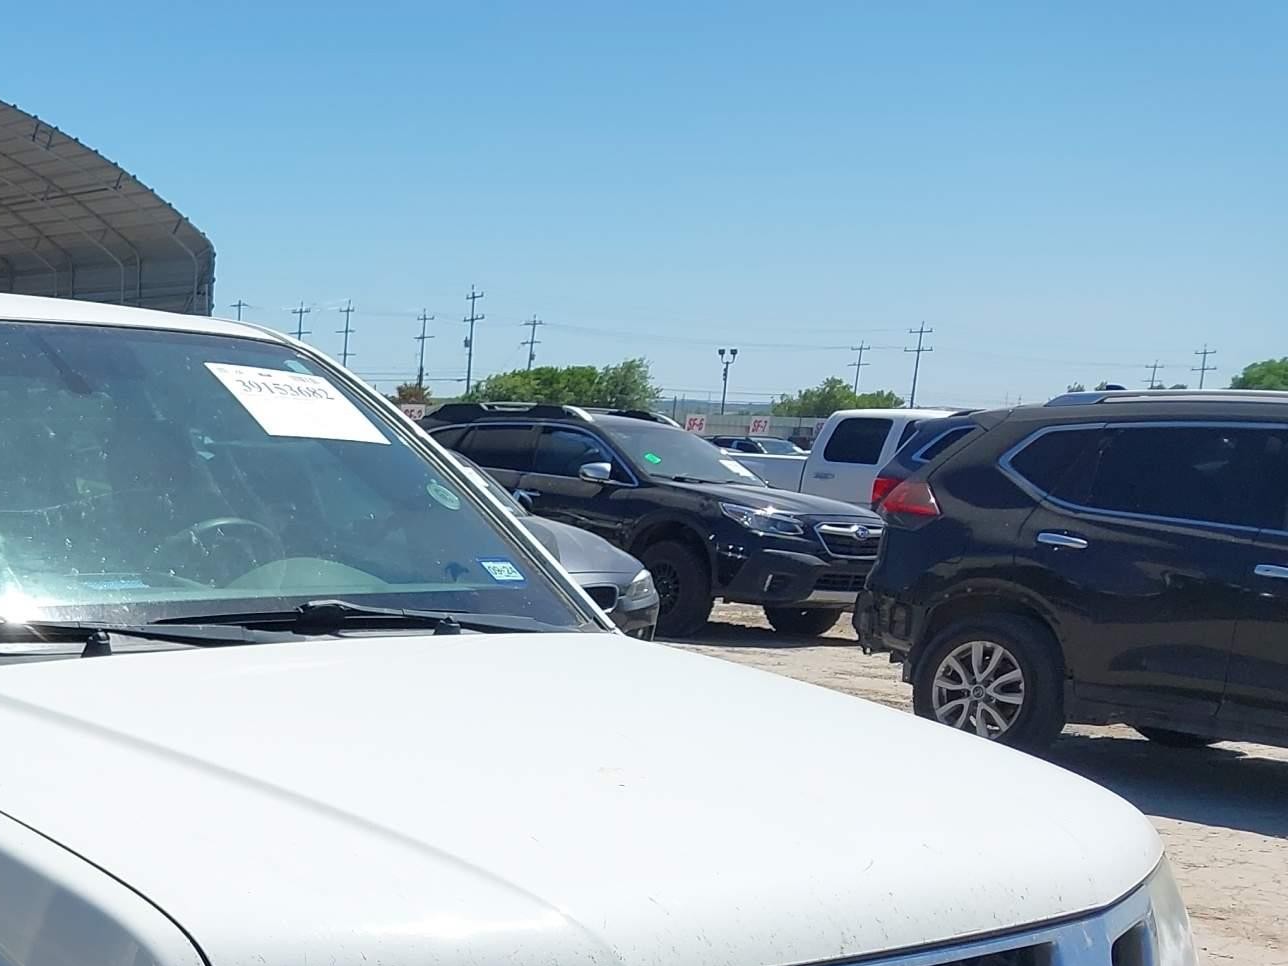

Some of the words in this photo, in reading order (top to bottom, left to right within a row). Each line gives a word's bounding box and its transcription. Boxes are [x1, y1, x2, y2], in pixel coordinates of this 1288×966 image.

[235, 379, 336, 401] 39153682
[686, 417, 705, 432] SF-6
[752, 419, 768, 433] SF-7
